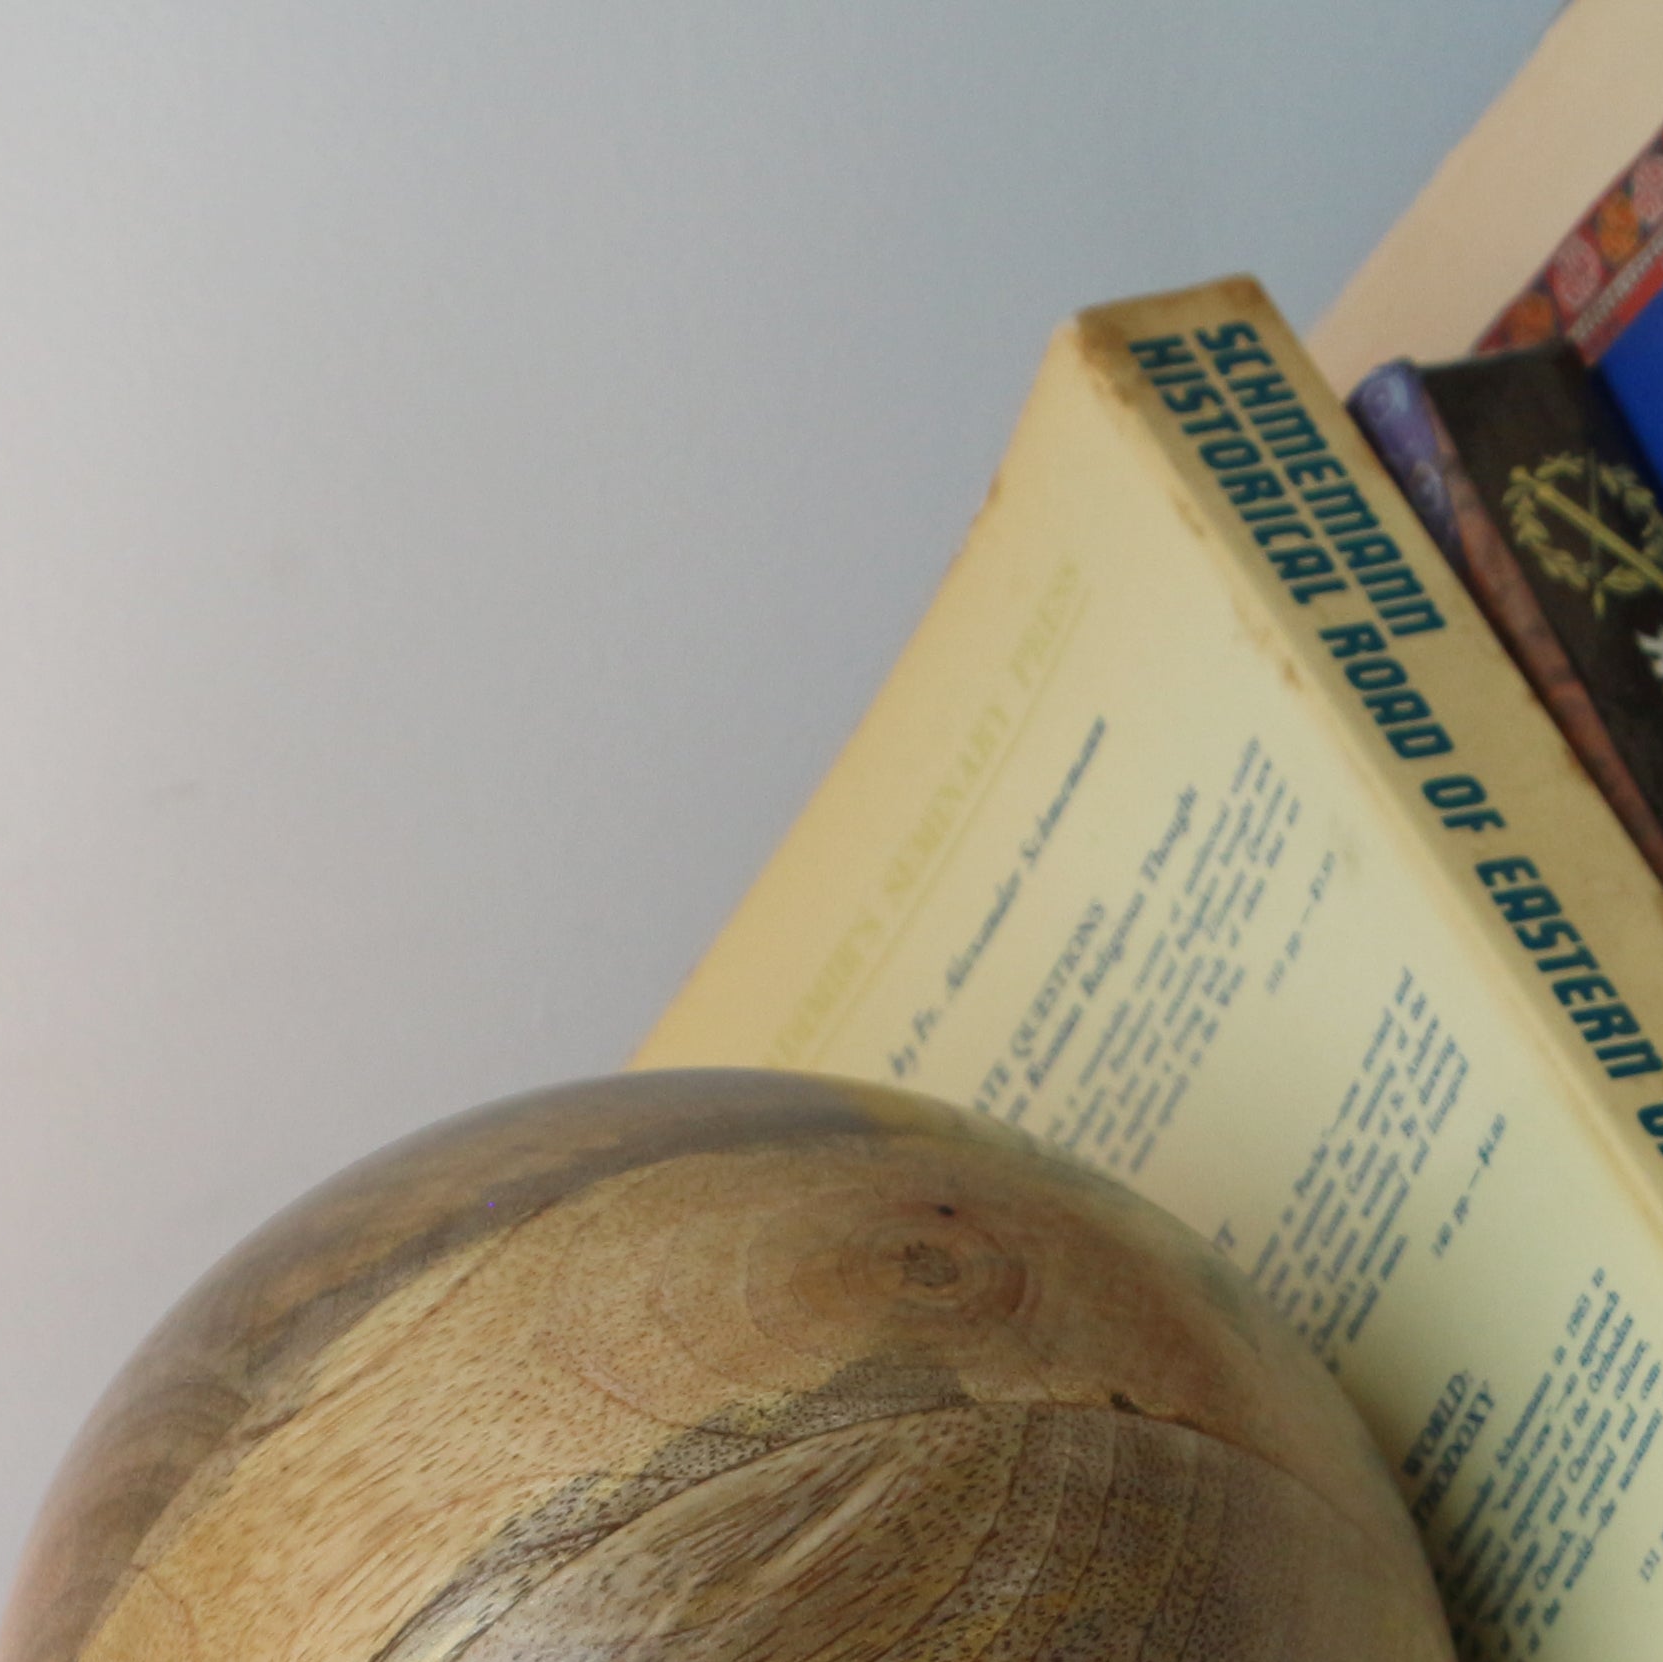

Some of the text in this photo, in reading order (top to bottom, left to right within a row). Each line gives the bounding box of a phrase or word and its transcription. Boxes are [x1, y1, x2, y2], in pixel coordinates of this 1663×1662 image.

[1194, 322, 1446, 637] SCHMEMANN
[1125, 334, 1348, 605] HISTORICAL
[1319, 622, 1455, 760] ROAD
[1421, 774, 1506, 834] OF
[942, 866, 1023, 996] Alexander
[1018, 711, 1109, 870] Schmemann
[1139, 781, 1199, 887] Thought
[1008, 899, 1106, 1063] QUESTIONS
[1494, 1370, 1552, 1470] Schmemann
[1552, 1342, 1567, 1367] in
[1590, 1265, 1606, 1290] to
[1558, 1427, 1573, 1454] of
[1571, 1396, 1590, 1429] the
[1587, 1311, 1634, 1396] Orthodox
[1577, 1288, 1620, 1370] approach
[1546, 1336, 1650, 1526] and Christian culture,
[1576, 1444, 1617, 1520] revealed
[1617, 1402, 1638, 1444] and
[1616, 1406, 1663, 1493] sacrament
